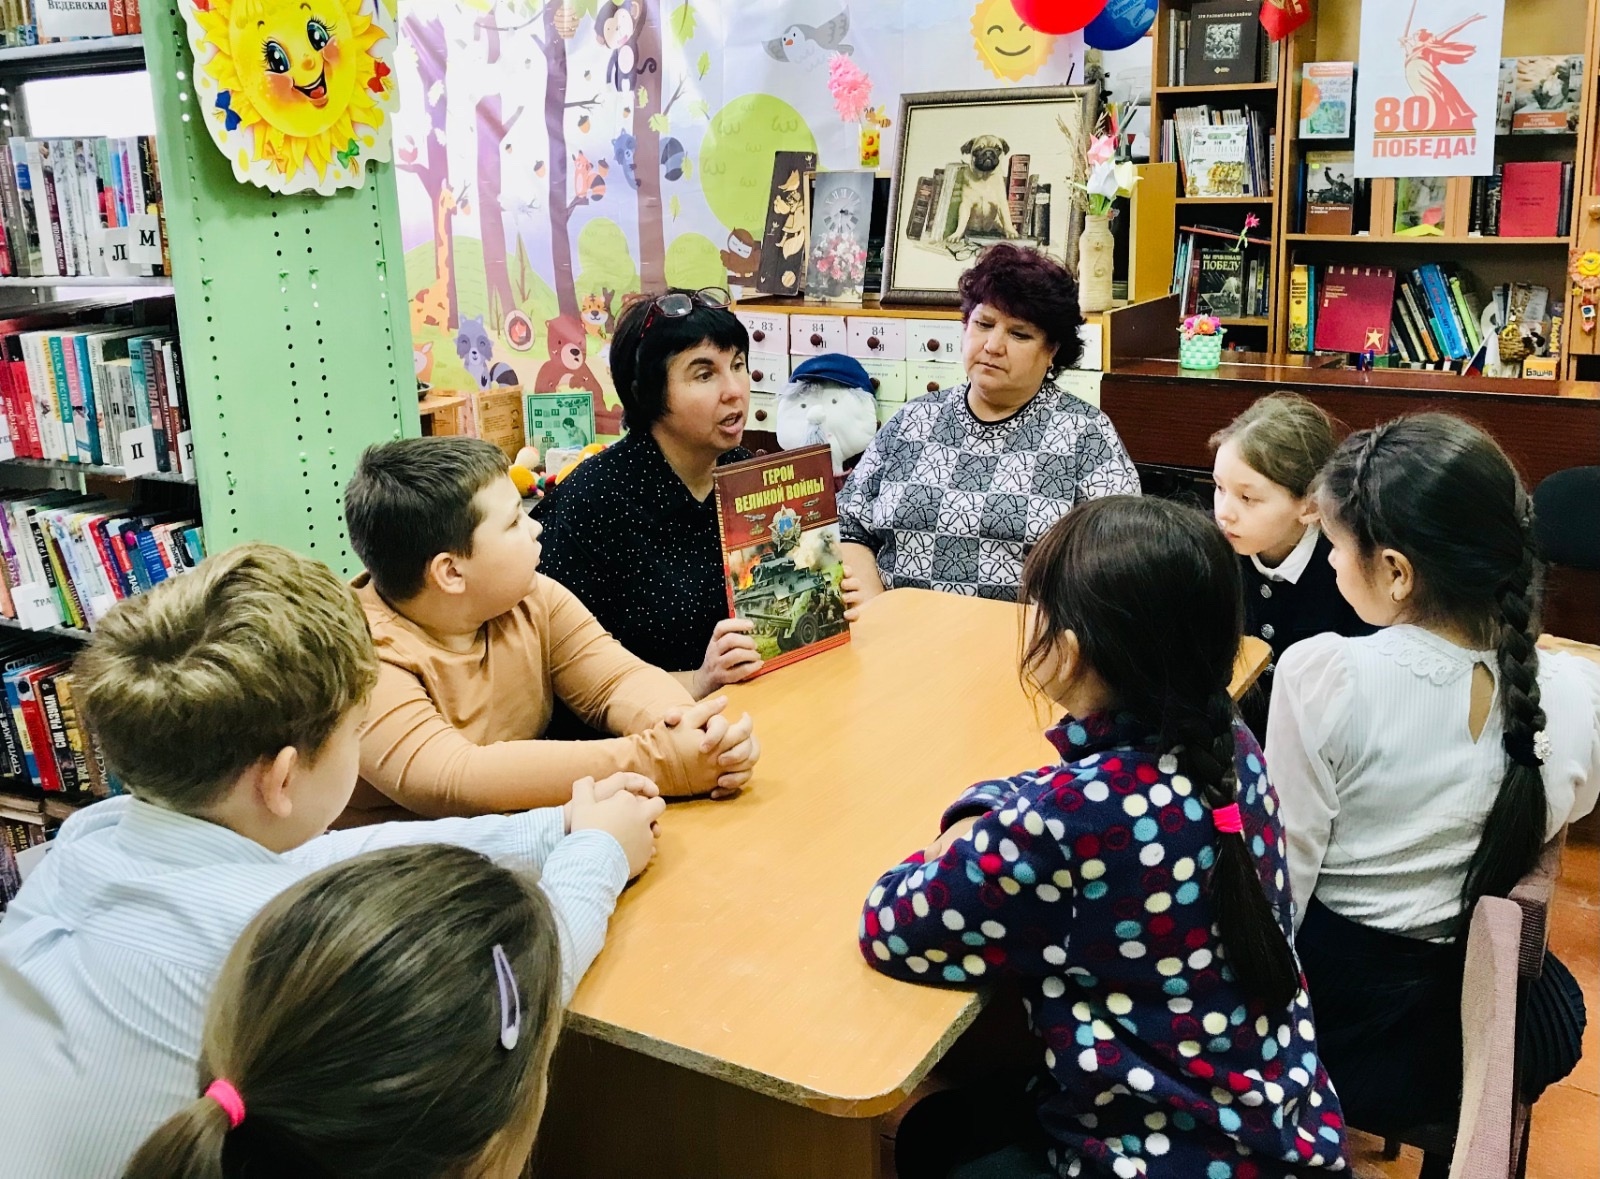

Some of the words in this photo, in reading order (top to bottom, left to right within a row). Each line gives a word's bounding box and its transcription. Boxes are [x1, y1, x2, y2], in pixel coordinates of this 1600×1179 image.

[1374, 96, 1430, 132] 80
[1372, 137, 1477, 159] ПОБЕДА!
[139, 229, 156, 247] М
[112, 244, 128, 261] Л
[1202, 260, 1242, 271] ПОБЕДУ
[761, 321, 774, 332] 83
[812, 323, 825, 333] 84
[871, 326, 885, 336] 84
[919, 342, 927, 352] А
[946, 343, 954, 352] В
[51, 340, 61, 376] НАТАЛЬЯ
[58, 378, 70, 420] НЕСТЕРОВА
[131, 442, 144, 460] П
[185, 443, 195, 460] Р
[762, 463, 796, 487] ГЕРОИ
[734, 483, 785, 514] ВЕЛИКОЙ
[785, 476, 825, 501] ВОЙНЫ
[43, 694, 63, 730] РАЗУМА
[1, 717, 21, 775] СТРУГАЦКИЕ
[52, 731, 67, 749] СОН
